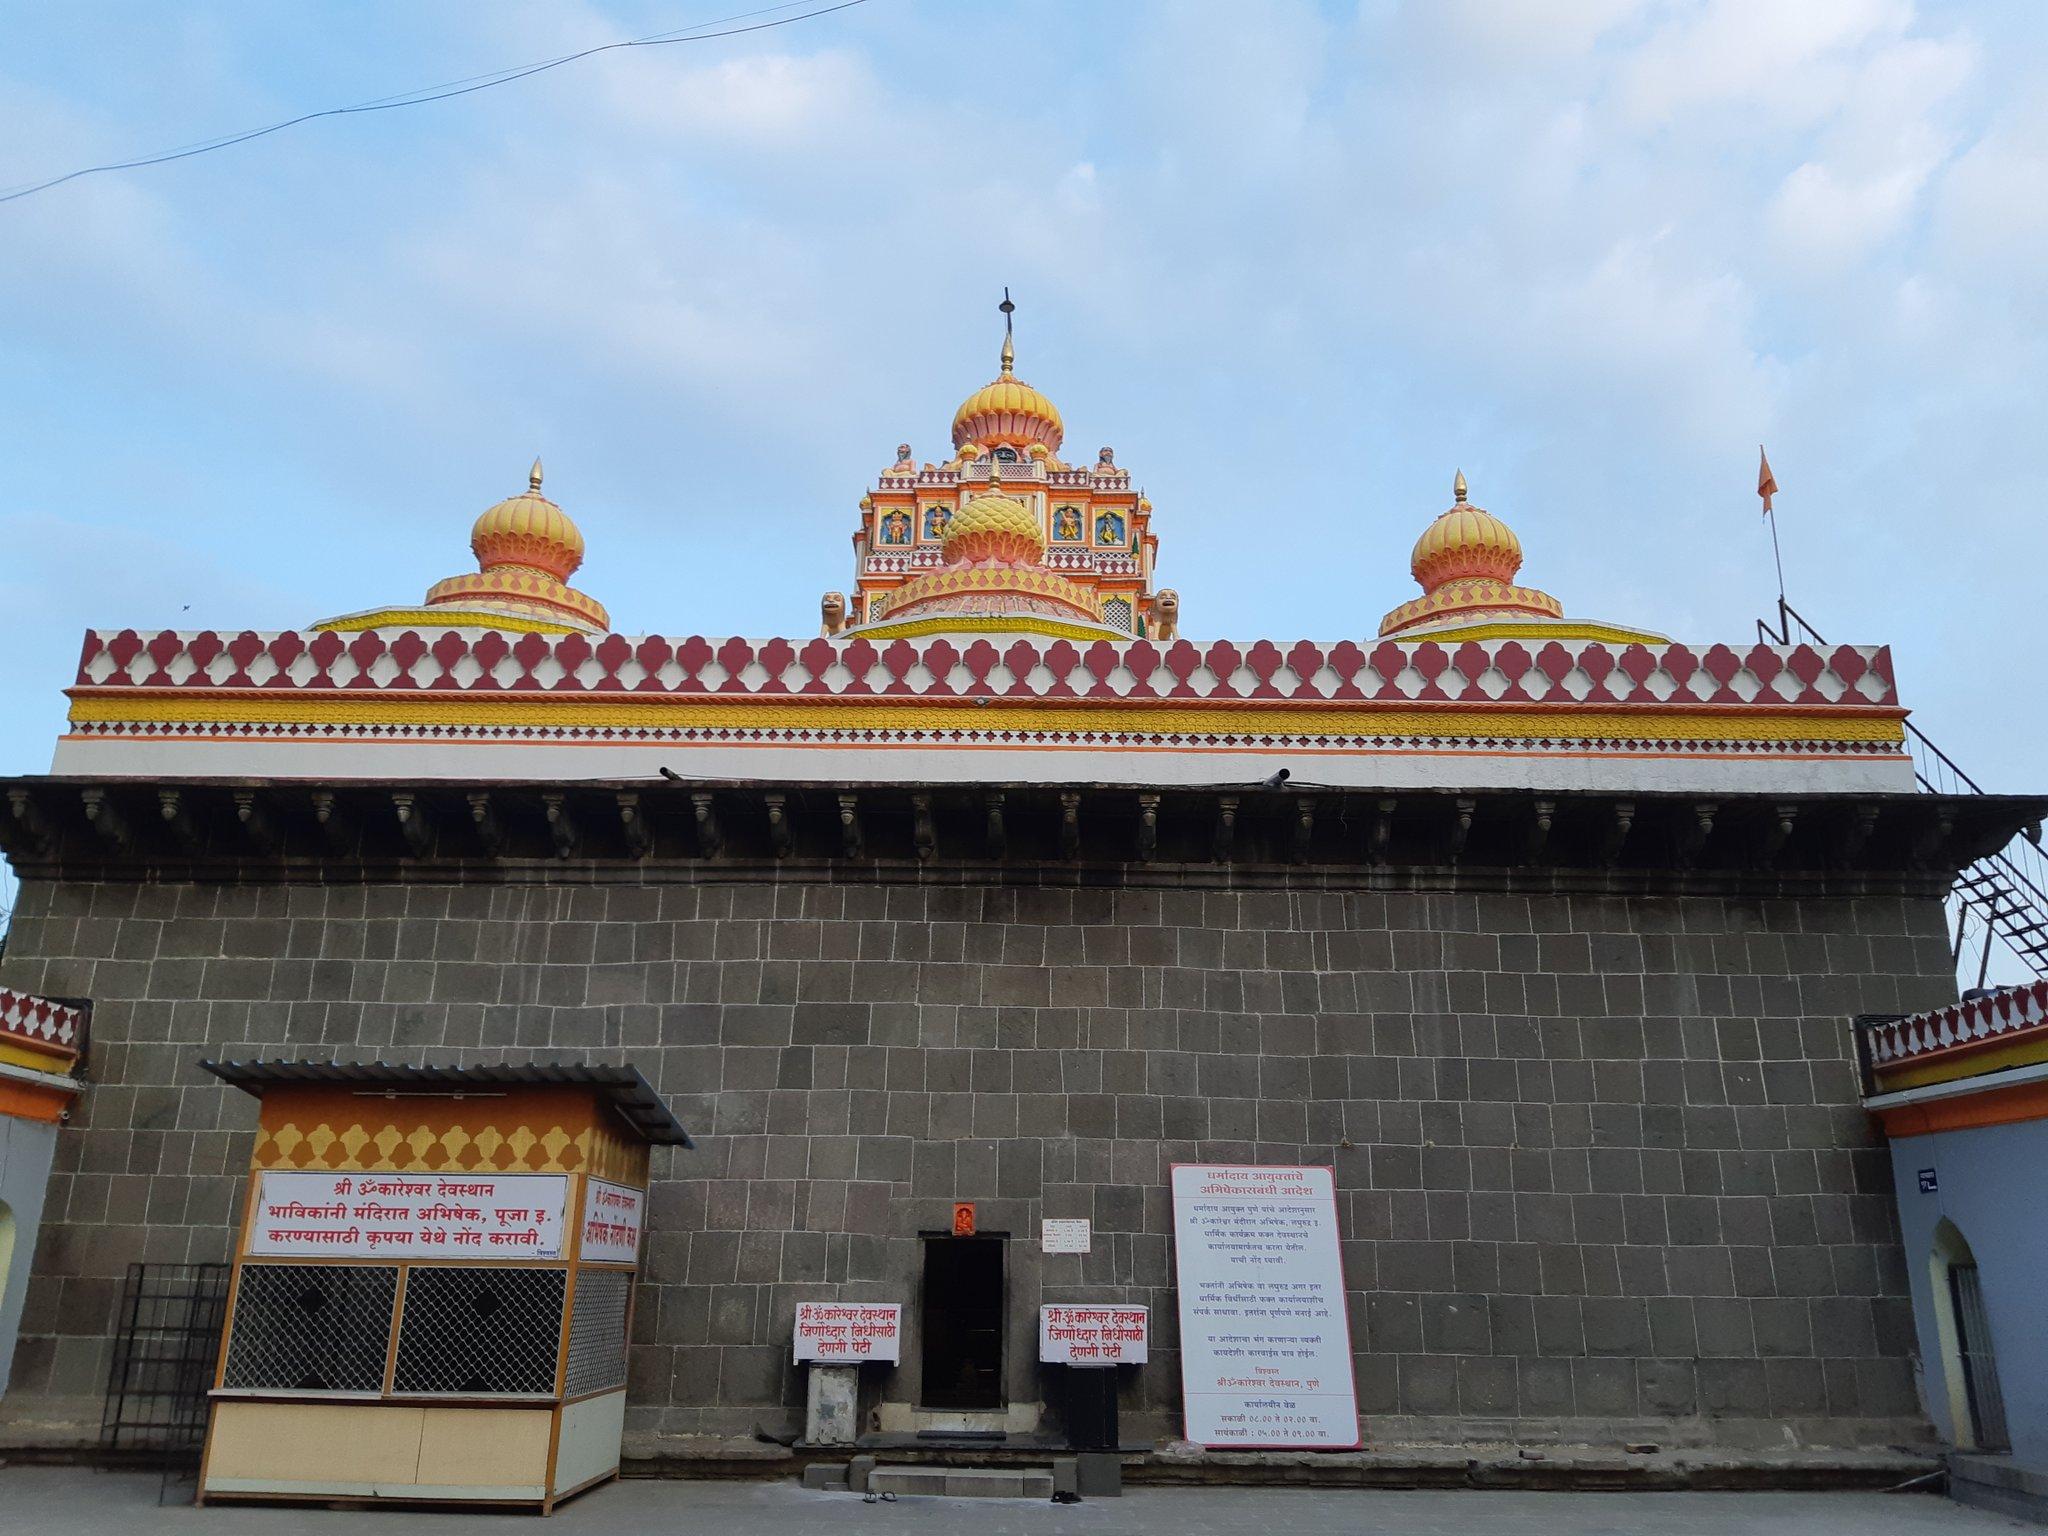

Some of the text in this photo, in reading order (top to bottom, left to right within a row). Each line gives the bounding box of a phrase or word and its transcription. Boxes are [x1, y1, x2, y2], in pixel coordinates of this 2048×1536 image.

[1208, 1171, 1304, 1183] धर्मादाय आयुक्तांचे
[334, 1178, 494, 1197] श्री ॐकारेश्वर देवस्थान
[1281, 1185, 1313, 1195] आदेश
[269, 1201, 551, 1228] भाविकांनी मंदिरात अभिषेक, पूजा इ.
[269, 1226, 543, 1249] करण्यासाठी कृपया येथे नोंद करावी.
[800, 1305, 811, 1320] श्री
[860, 1306, 896, 1323] देवस्थान
[1048, 1308, 1062, 1323] श्री
[1112, 1309, 1145, 1326] देवस्थान
[851, 1322, 896, 1337] निधीसाठी
[1101, 1325, 1143, 1341] निधीसाठी
[818, 1338, 872, 1356] देणगी पेटी
[1070, 1343, 1121, 1360] देणगी पेटी
[1306, 1378, 1319, 1390] पुणे
[1221, 1414, 1246, 1422] सकाळी
